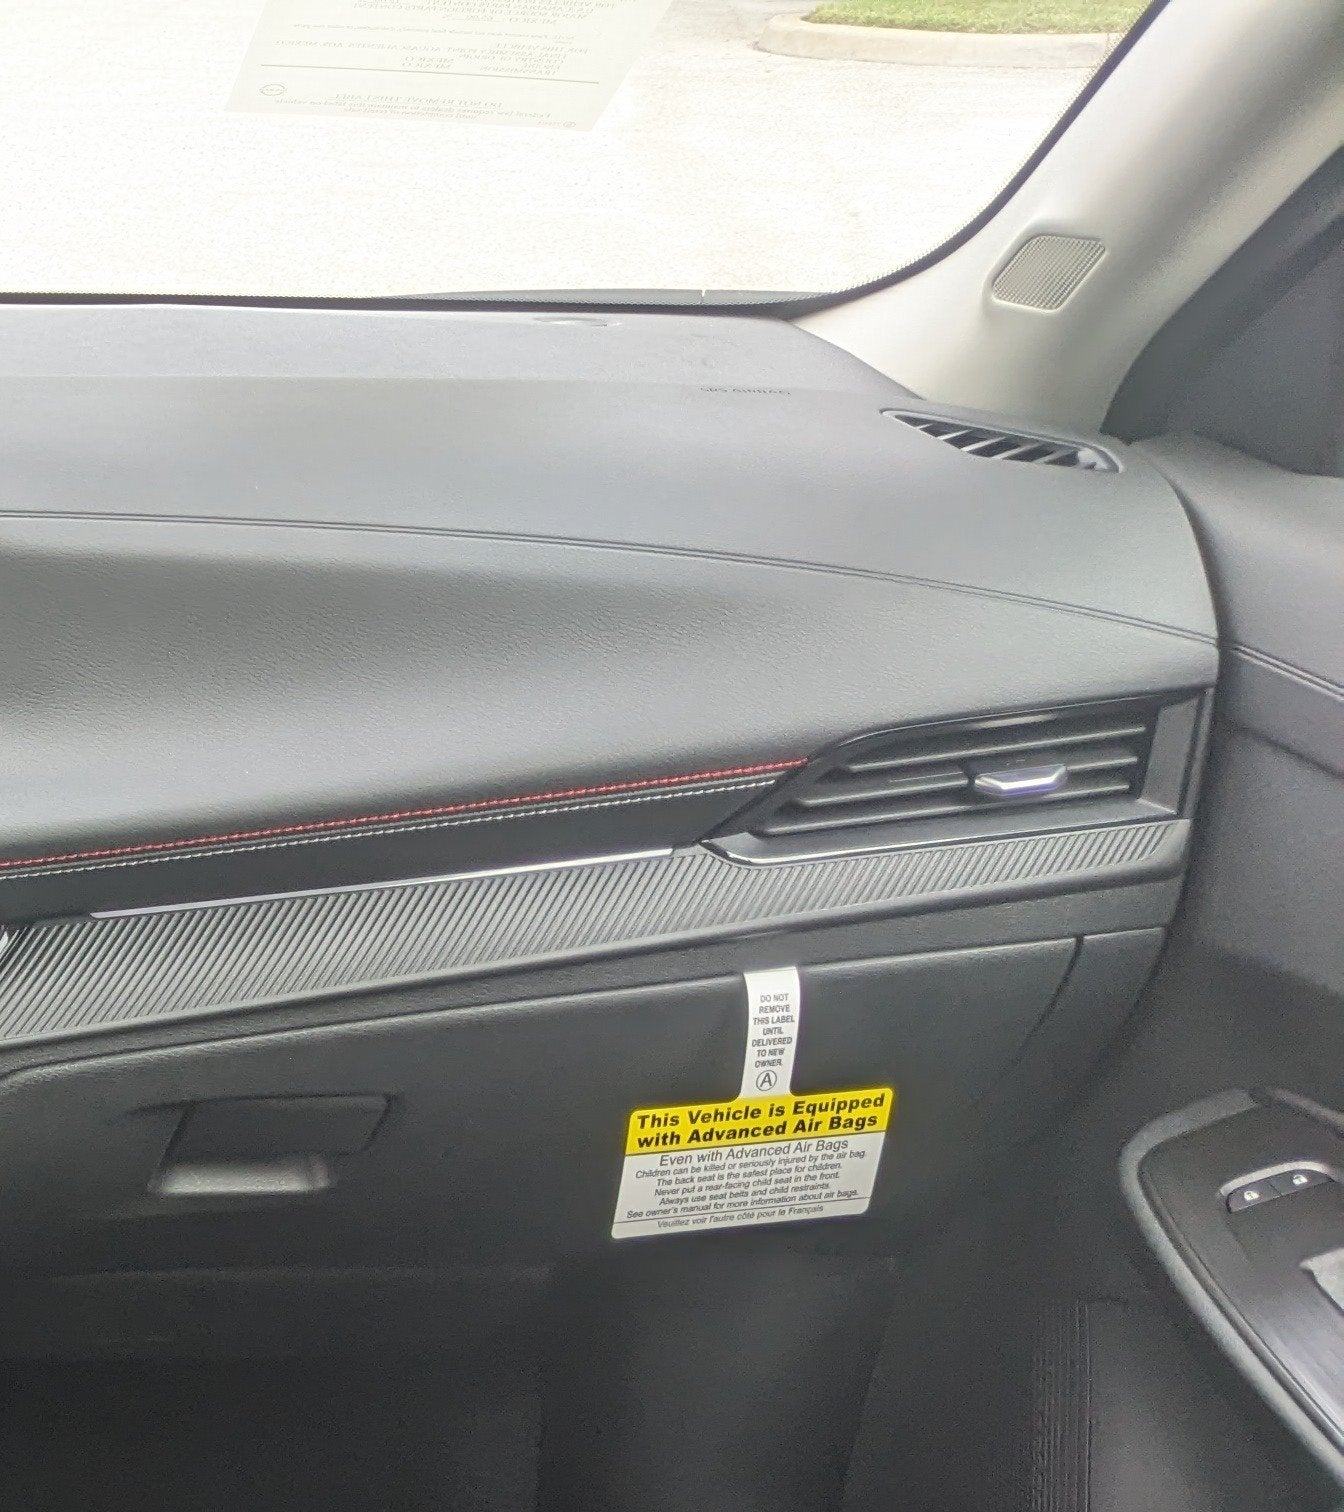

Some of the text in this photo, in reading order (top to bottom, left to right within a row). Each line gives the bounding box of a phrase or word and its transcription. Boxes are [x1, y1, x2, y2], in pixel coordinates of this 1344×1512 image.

[759, 1004, 791, 1014] REMOVE
[760, 993, 789, 1003] DO NOT
[753, 1015, 795, 1026] THIS LABEL
[762, 1027, 784, 1036] UNTIL
[752, 1036, 793, 1048] DELIVERED
[757, 1048, 786, 1058] TO NEW
[760, 1072, 772, 1088] A
[637, 1092, 885, 1130] This Vehicle is Equipped
[637, 1115, 878, 1148] with Advanced Air Bags
[660, 1140, 848, 1166] Even with Advanced Air Bags
[635, 1168, 671, 1179] Children
[673, 1166, 688, 1175] can
[690, 1164, 702, 1174] be
[704, 1162, 726, 1172] killed
[728, 1162, 736, 1170] or
[738, 1156, 776, 1169] seriously
[778, 1154, 806, 1166] injured
[808, 1154, 819, 1163] by
[820, 1152, 833, 1161] the
[836, 1151, 848, 1159] air
[657, 1178, 672, 1187] The
[674, 1176, 694, 1186] back
[697, 1174, 716, 1183] seat
[717, 1173, 725, 1181] is
[727, 1170, 740, 1180] the
[742, 1168, 768, 1179] safest
[770, 1166, 792, 1177] place
[794, 1164, 806, 1173] for
[654, 1187, 680, 1197] Never
[681, 1186, 696, 1196] put
[705, 1180, 750, 1192] rear-facing
[752, 1176, 772, 1187] child
[774, 1174, 792, 1184] seat
[794, 1174, 802, 1182] in
[804, 1172, 818, 1182] the
[658, 1196, 689, 1206] Always
[691, 1194, 706, 1203] use
[709, 1192, 727, 1202] seat
[729, 1190, 749, 1200] belts
[751, 1187, 768, 1197] and
[769, 1184, 789, 1196] child
[627, 1210, 644, 1219] See
[646, 1206, 678, 1217] owner's
[680, 1202, 712, 1213] manual
[714, 1200, 724, 1210] for
[726, 1200, 748, 1209] more
[750, 1194, 797, 1207] information
[798, 1192, 822, 1202] about
[824, 1190, 835, 1200] air
